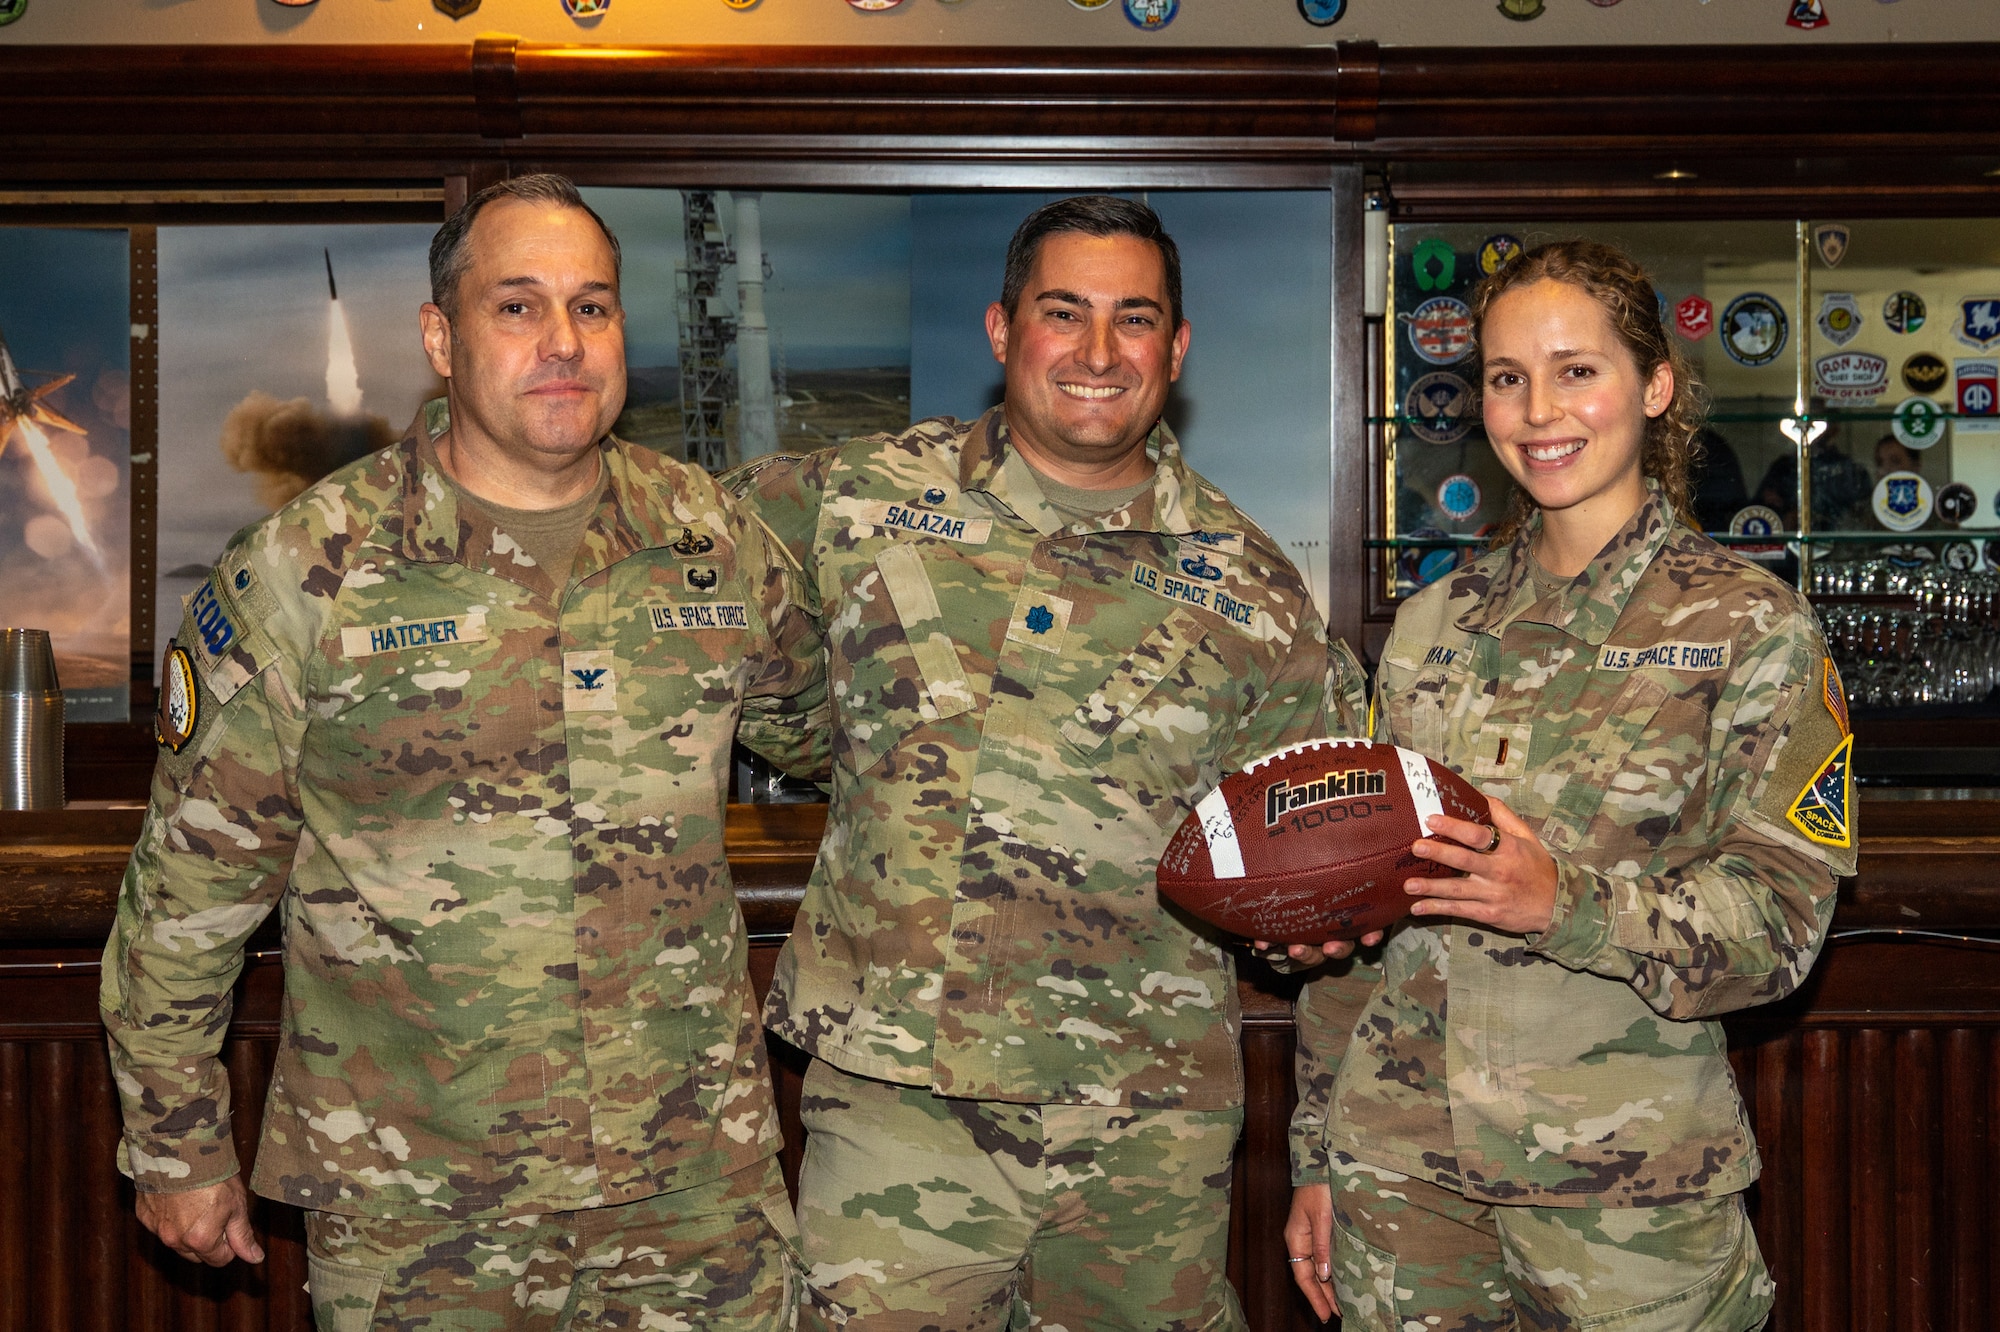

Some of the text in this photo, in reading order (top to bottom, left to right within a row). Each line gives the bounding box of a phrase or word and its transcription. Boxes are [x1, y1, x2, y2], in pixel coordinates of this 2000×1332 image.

[1822, 357, 1881, 375] RON JON
[885, 505, 966, 539] SALAZAR
[1134, 564, 1255, 625] U.S. SPACE FORCE
[652, 605, 748, 629] U.S. SPACE FORCE
[370, 620, 459, 653] HATCHER
[1603, 644, 1724, 669] U.S. SPACE FORCE
[1805, 810, 1836, 832] SPACE
